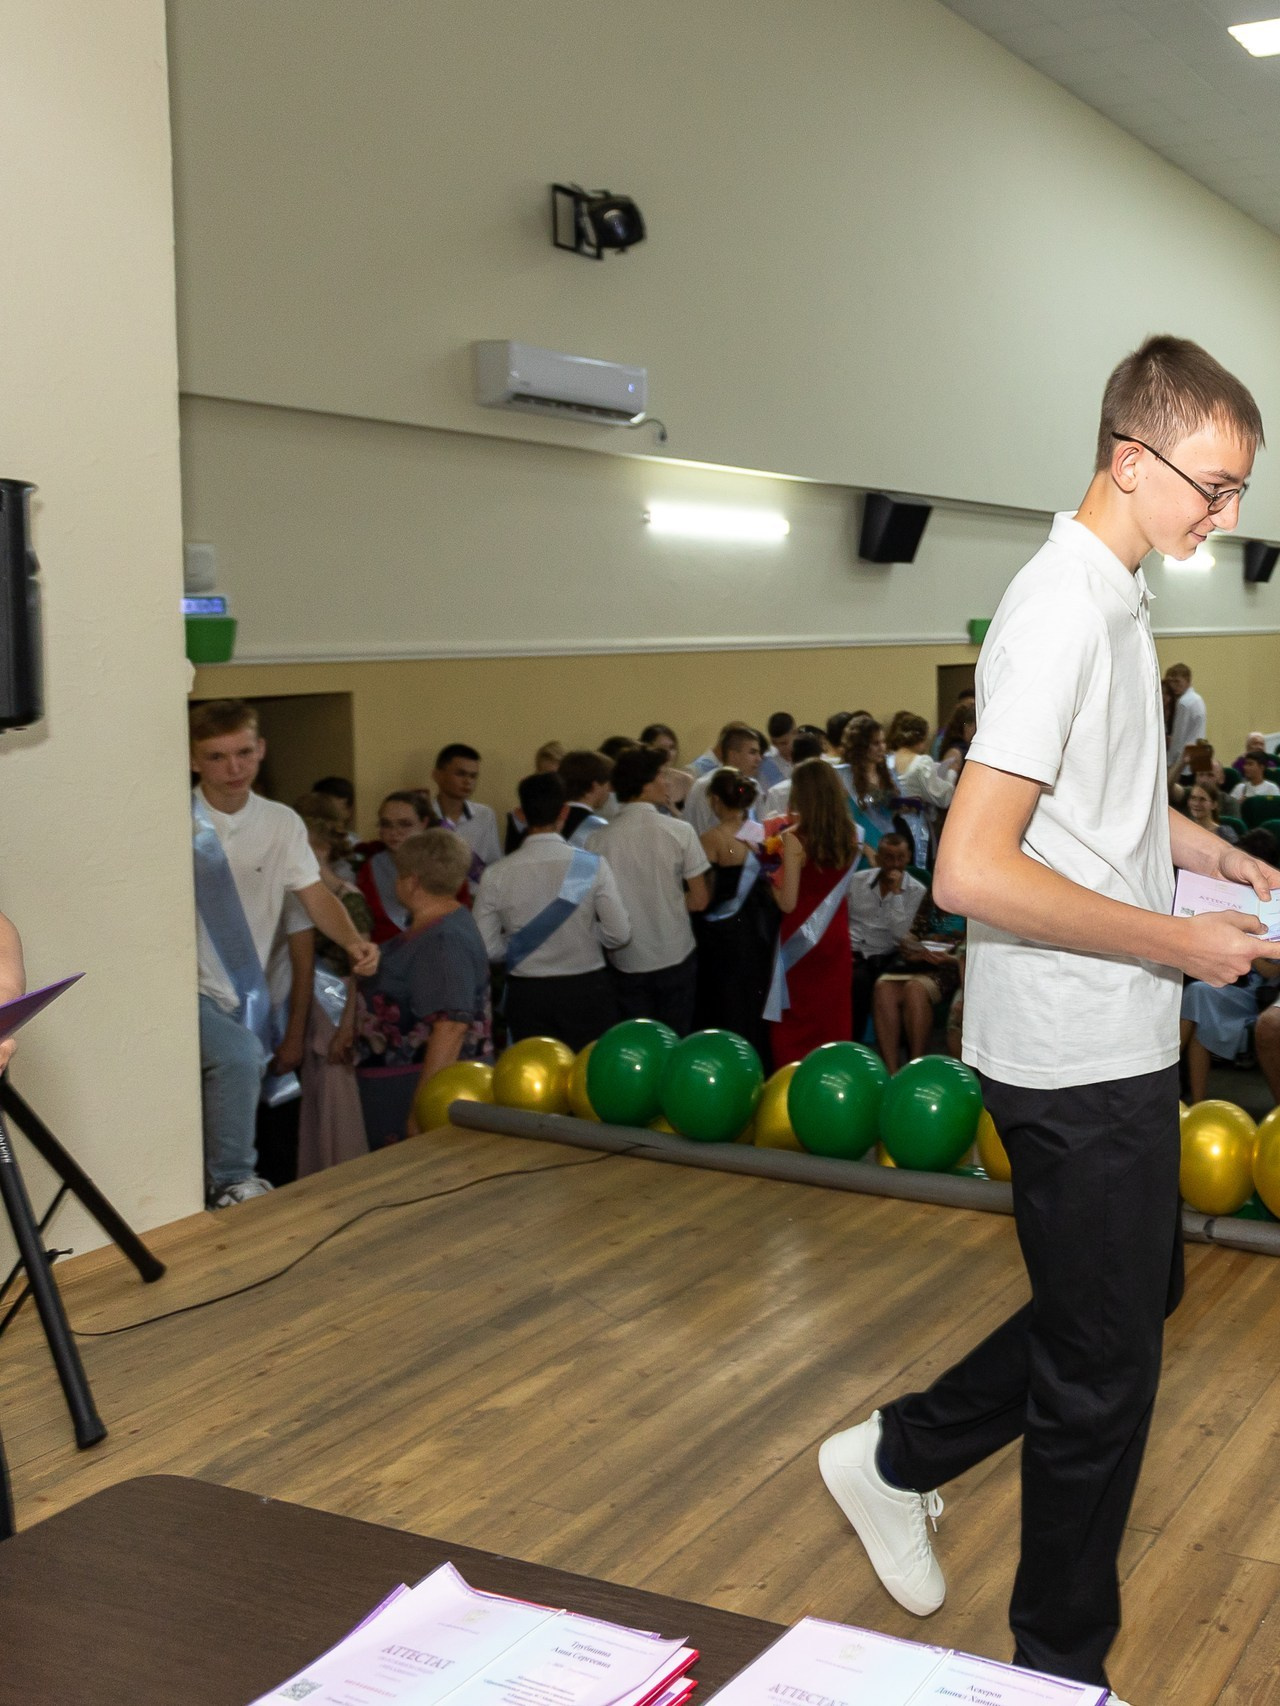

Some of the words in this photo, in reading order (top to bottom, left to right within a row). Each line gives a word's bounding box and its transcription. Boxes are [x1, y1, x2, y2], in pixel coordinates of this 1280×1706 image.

[381, 1644, 455, 1670] АТТЕСТАТ
[551, 1646, 572, 1657] Анна
[572, 1652, 611, 1669] Сергеевна
